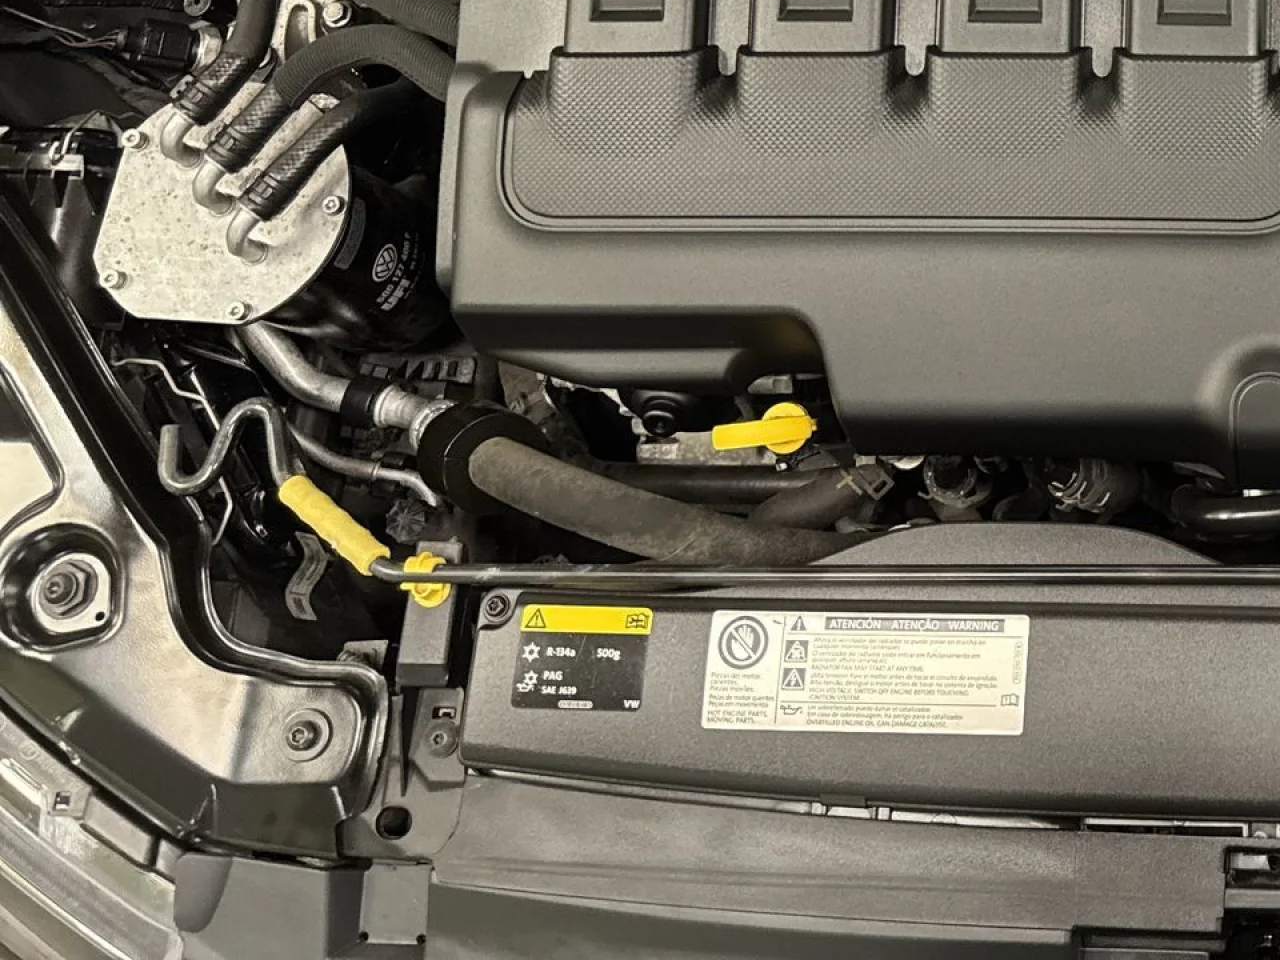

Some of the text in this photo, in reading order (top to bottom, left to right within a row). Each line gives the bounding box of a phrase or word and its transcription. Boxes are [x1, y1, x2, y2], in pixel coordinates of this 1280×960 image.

[830, 616, 1000, 632] ATENCIÓN ATENÇÃO WARNING
[546, 647, 621, 660] R-134a 500g
[543, 670, 564, 681] PAG
[541, 686, 556, 695] SAE
[623, 700, 640, 709] VW
